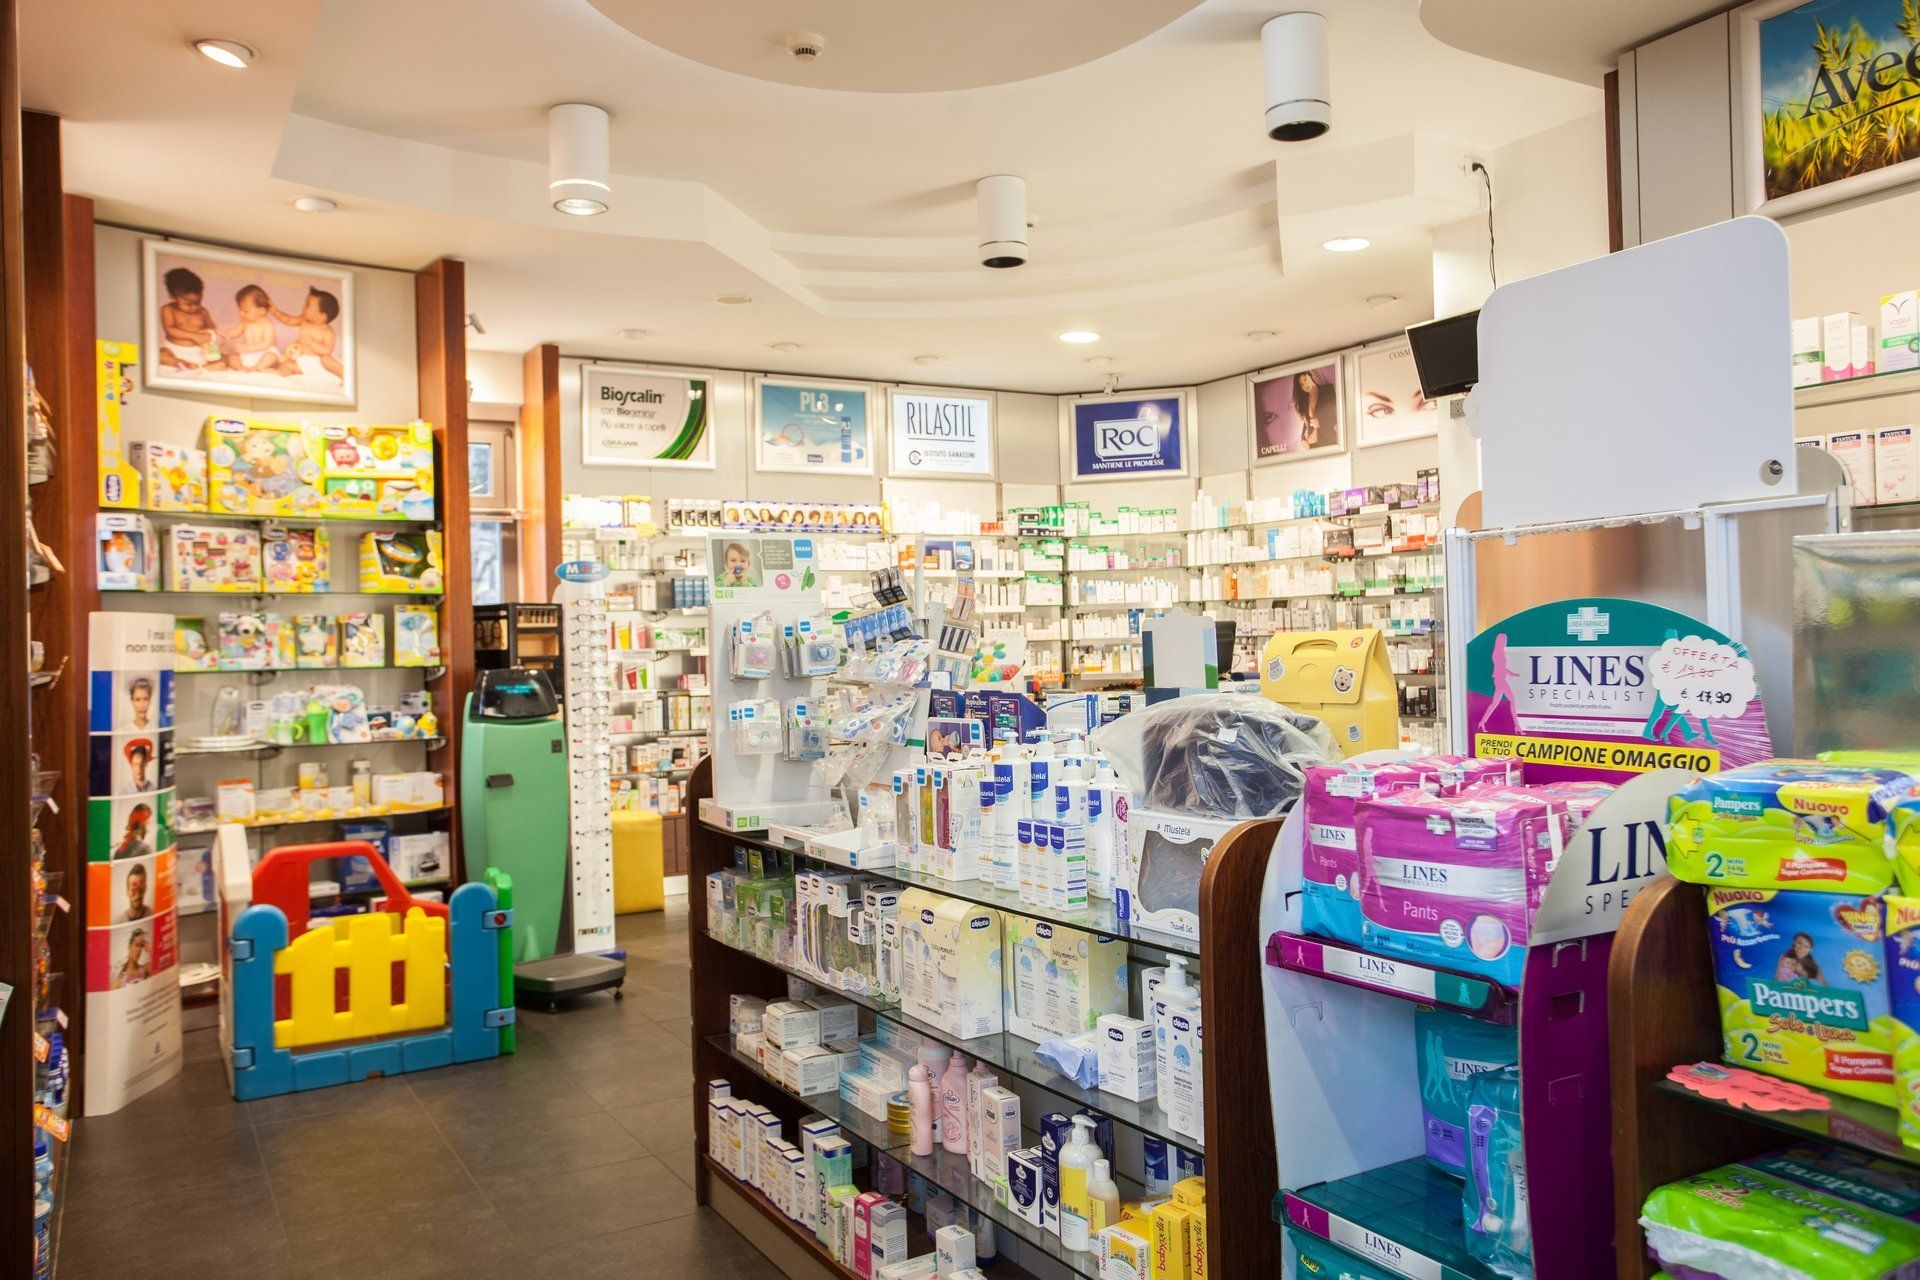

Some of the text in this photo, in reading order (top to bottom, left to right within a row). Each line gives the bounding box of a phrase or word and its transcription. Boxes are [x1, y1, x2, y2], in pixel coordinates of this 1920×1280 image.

[600, 386, 662, 405] Bioscalin
[800, 391, 829, 413] PL3
[907, 401, 975, 437] RILASTIL
[1101, 425, 1153, 451] RoC
[924, 450, 975, 459] ISTITUTO GANASSINI
[1261, 444, 1287, 455] CAPELLI
[1092, 461, 1124, 469] MANTIENE
[1133, 459, 1164, 467] PROMESSE
[1662, 660, 1671, 673] €
[1673, 647, 1738, 669] OFFERTA
[1528, 654, 1645, 688] LINES
[1528, 687, 1645, 702] SPECIALIST
[1697, 690, 1732, 704] 17,90
[1480, 738, 1513, 748] PRENDI
[1482, 747, 1511, 756] IL TUO
[1516, 741, 1711, 773] CAMPIONE OMAGGIO
[1714, 796, 1761, 813] Pampers
[1164, 824, 1191, 836] Mustela
[1320, 827, 1346, 841] LINES
[1320, 856, 1338, 868] Pants
[1706, 852, 1725, 878] 2
[1402, 864, 1448, 883] LINES
[1402, 900, 1438, 921] Pants
[971, 918, 989, 928] chicco
[1170, 921, 1193, 934] Travel Set
[1359, 956, 1395, 976] LINES
[1752, 982, 1860, 1021] Pampers
[1173, 1019, 1189, 1031] chicco
[1766, 1012, 1856, 1042] Sole e Luna
[1740, 1031, 1763, 1063] 2
[1829, 1062, 1852, 1074] Super
[1841, 1055, 1882, 1066] Pampers
[1767, 1161, 1904, 1209] Pampers
[1157, 1216, 1166, 1271] babygella
[1194, 1219, 1204, 1276] babygella
[1364, 1231, 1401, 1259] LINES
